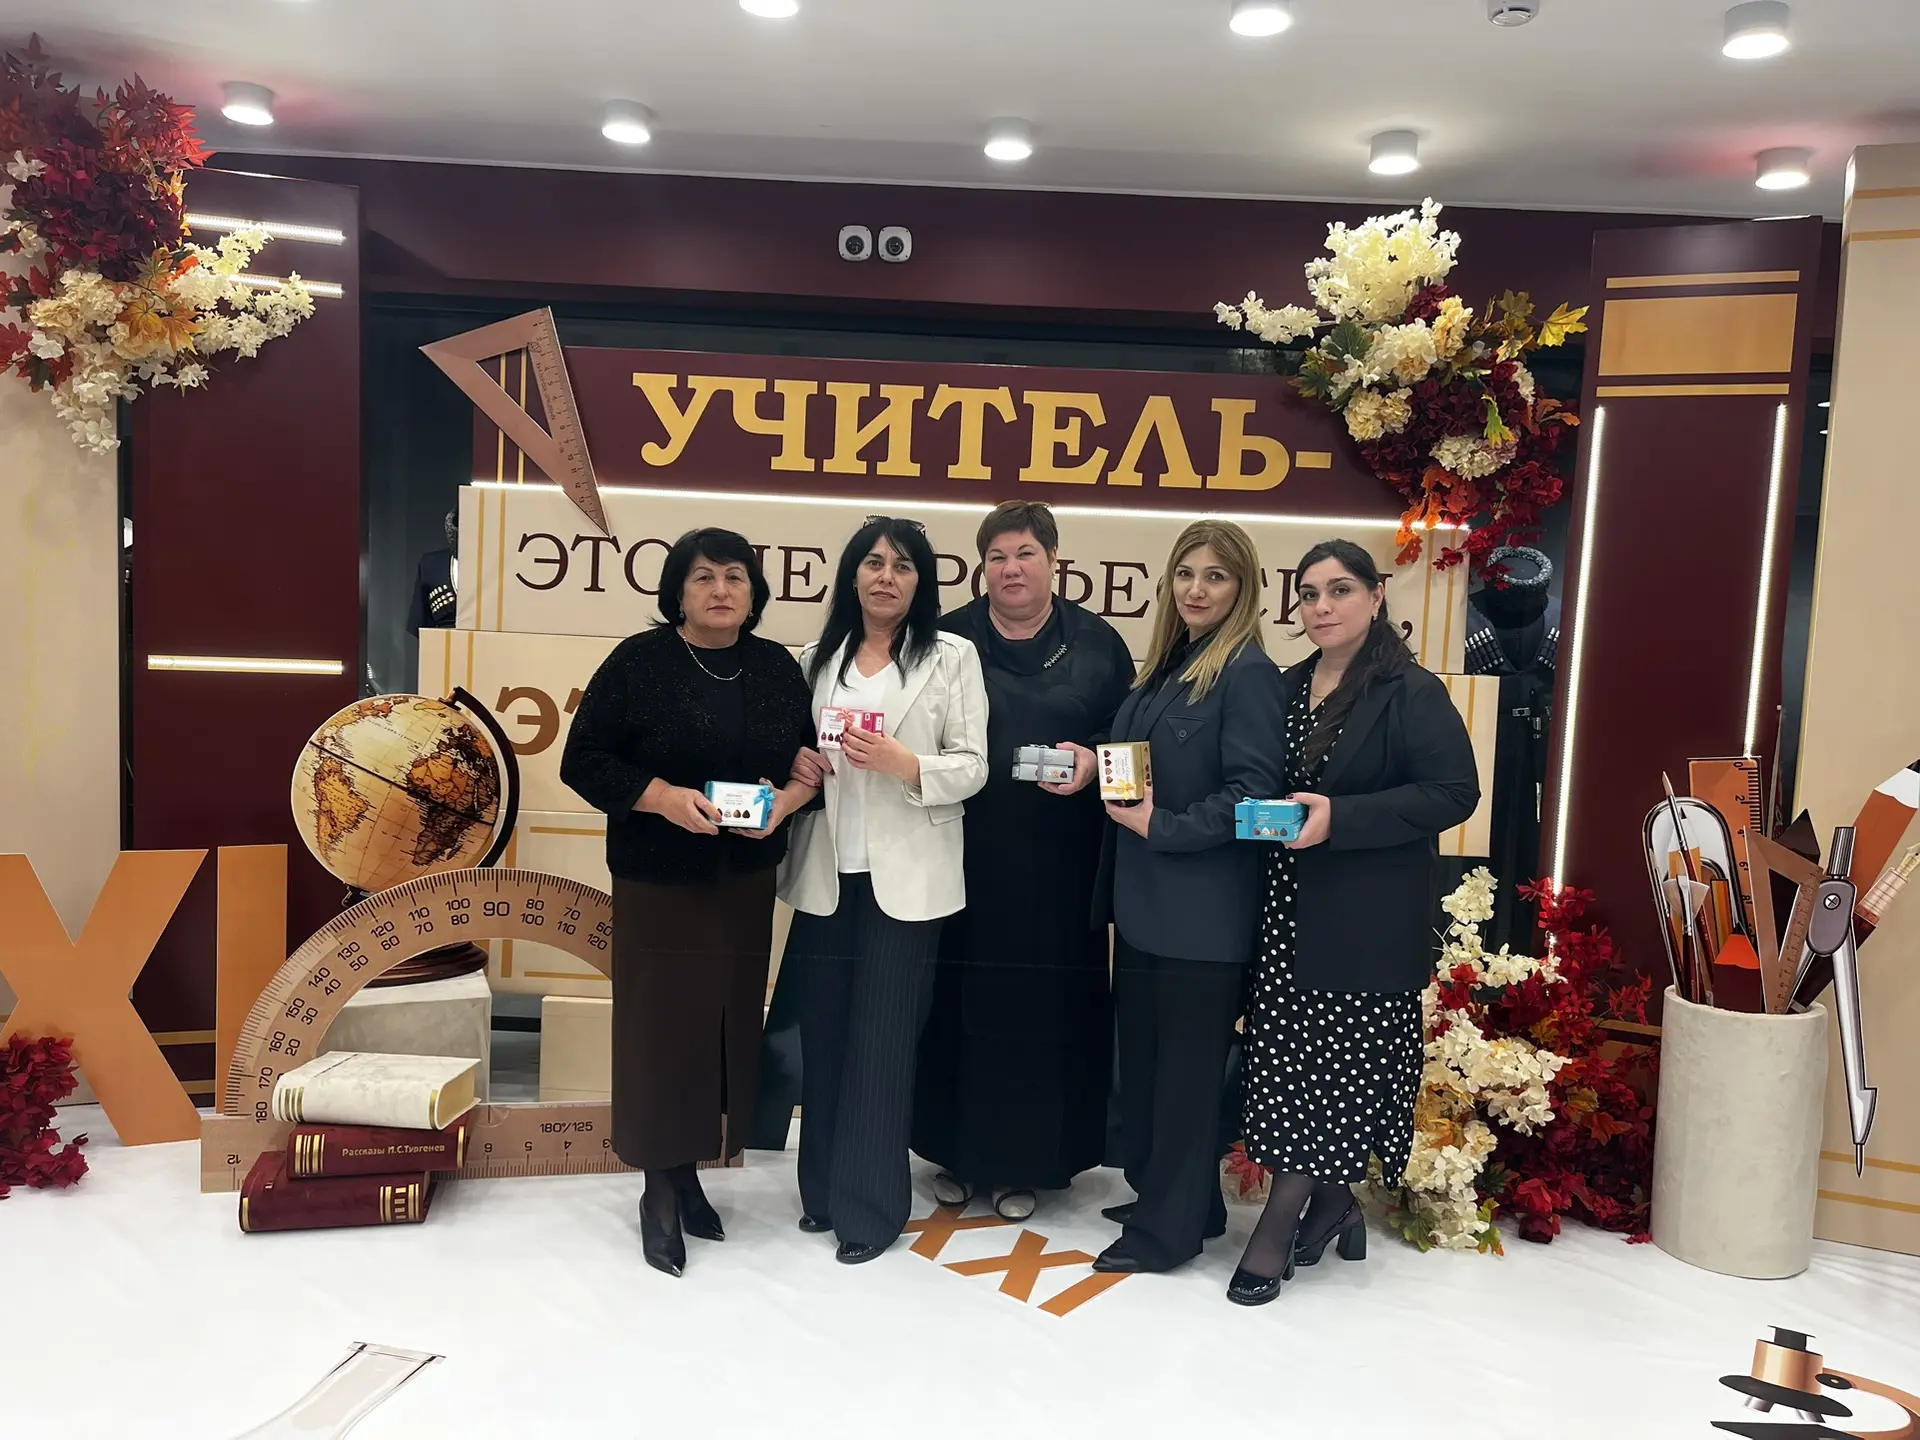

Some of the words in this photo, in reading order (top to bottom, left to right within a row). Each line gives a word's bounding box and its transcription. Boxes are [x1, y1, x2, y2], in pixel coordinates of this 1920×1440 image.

[632, 372, 1332, 491] УЧИТЕЛЬ-
[445, 898, 471, 911] 100
[483, 901, 510, 917] 90
[525, 898, 544, 911] 80
[408, 906, 430, 921] 110
[563, 906, 581, 921] 70
[370, 920, 395, 938] 120
[596, 921, 612, 937] 60
[337, 941, 360, 960] 130
[285, 1038, 301, 1057] 20
[301, 1007, 318, 1025] 30
[324, 978, 342, 997] 40
[349, 954, 369, 972] 50
[380, 934, 401, 951] 60
[414, 921, 434, 936] 70
[450, 913, 469, 926] 80
[520, 913, 544, 926] 100
[556, 920, 577, 936] 110
[587, 933, 608, 951] 120
[308, 967, 331, 988] 140
[285, 998, 305, 1019] 150
[268, 1031, 286, 1052] 160
[259, 1066, 273, 1089] 170
[255, 1101, 268, 1123] 180
[484, 1143, 493, 1153] 6
[524, 1141, 533, 1151] 5
[563, 1140, 572, 1149] 4
[602, 1138, 610, 1148] 3
[227, 1154, 242, 1165] 12
[342, 1147, 385, 1157] Рассказы
